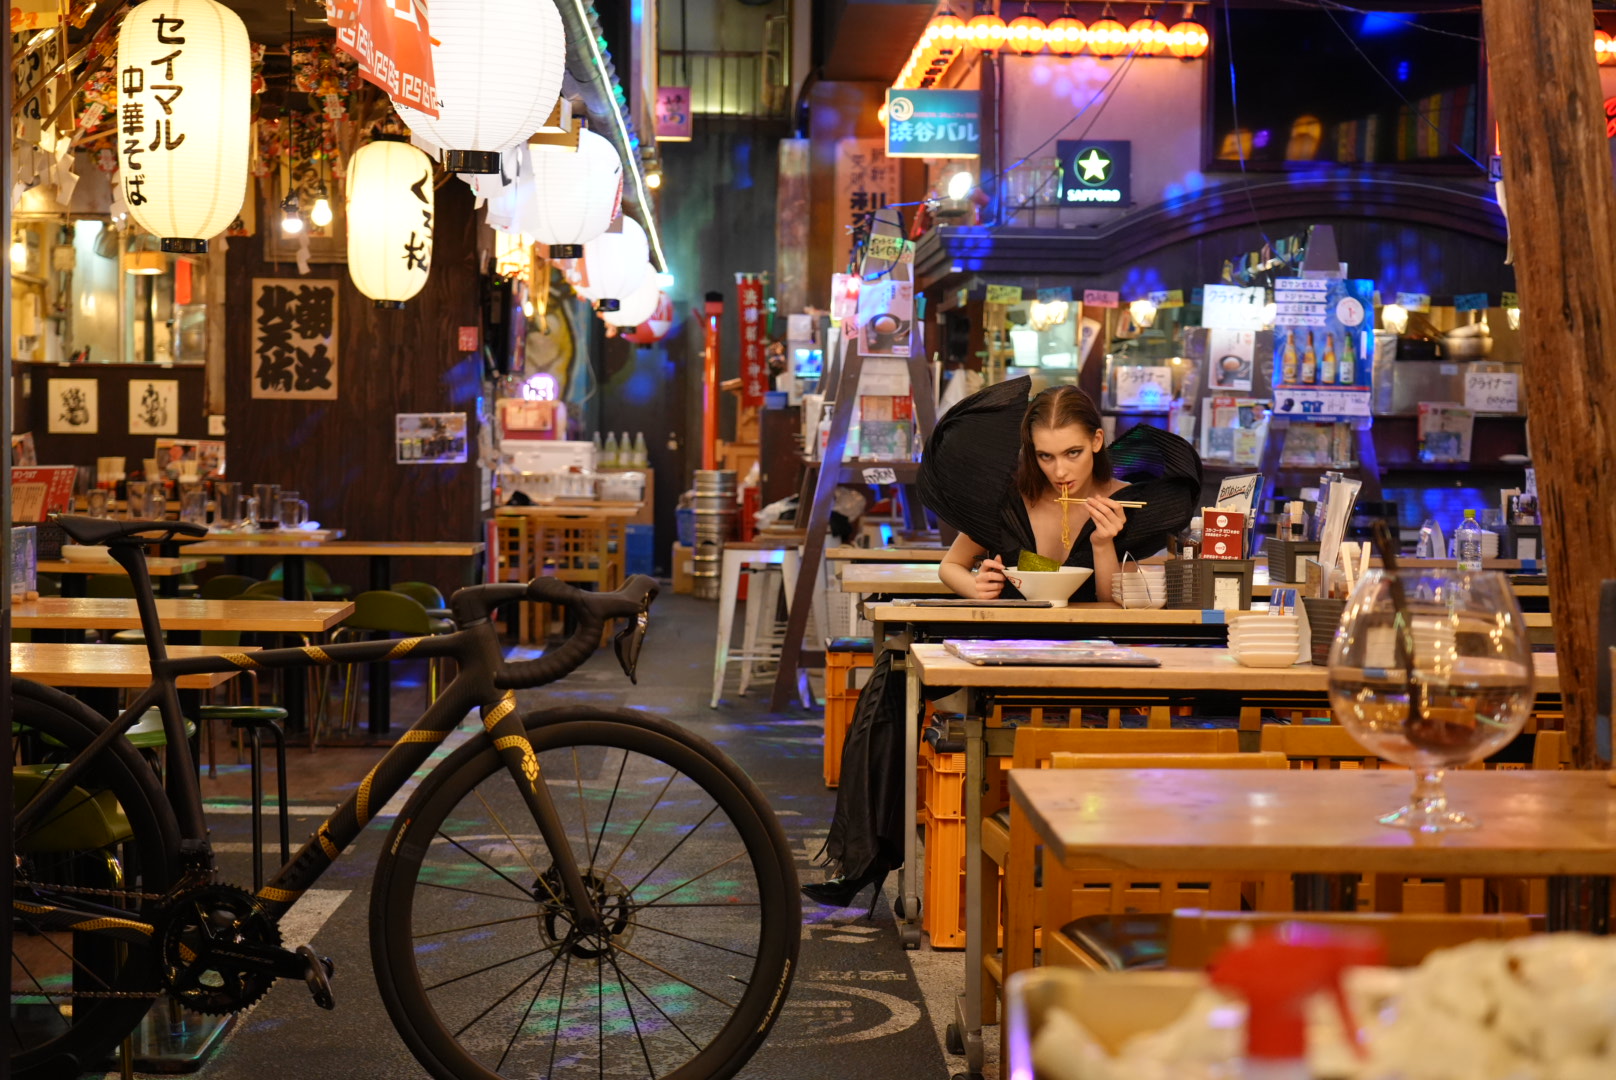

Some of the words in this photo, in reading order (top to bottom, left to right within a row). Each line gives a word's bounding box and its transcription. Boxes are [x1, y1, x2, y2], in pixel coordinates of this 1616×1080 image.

[149, 13, 186, 152] セイマル
[121, 65, 148, 206] 中華そば
[889, 120, 980, 142] 渋谷バル
[1066, 188, 1121, 202] SAPPORO
[1280, 280, 1321, 289] ロサンゼルス
